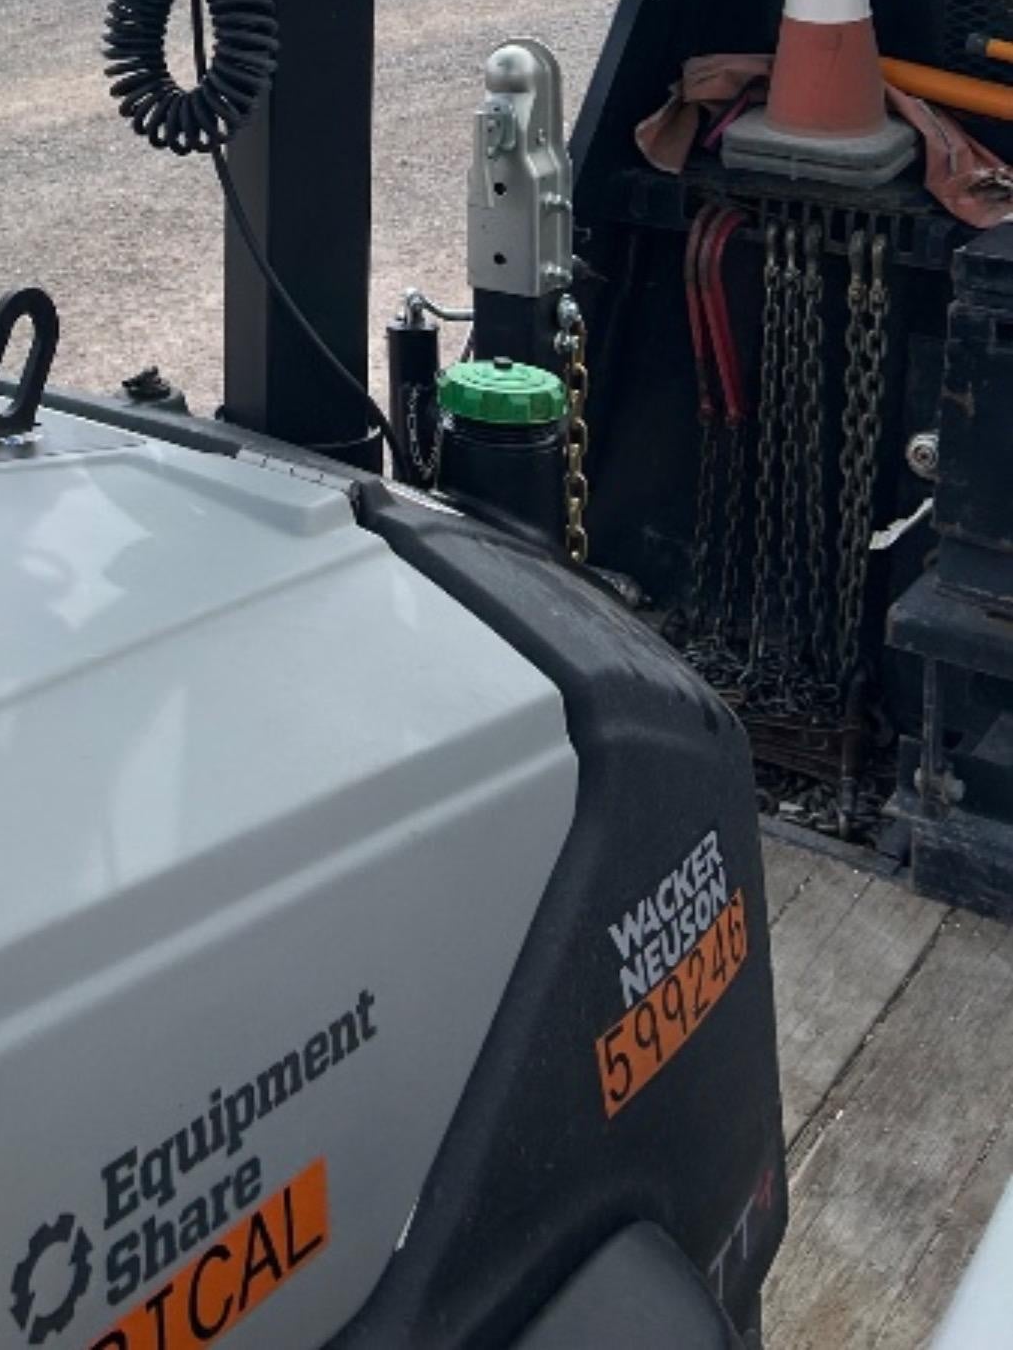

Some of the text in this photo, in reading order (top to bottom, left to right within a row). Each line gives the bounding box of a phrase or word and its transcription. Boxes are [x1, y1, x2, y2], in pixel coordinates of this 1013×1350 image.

[608, 830, 724, 959] WACKER
[619, 867, 727, 1009] NEUSON
[604, 900, 745, 1102] 599246
[101, 989, 377, 1230] Equipment
[106, 1156, 261, 1306] Share
